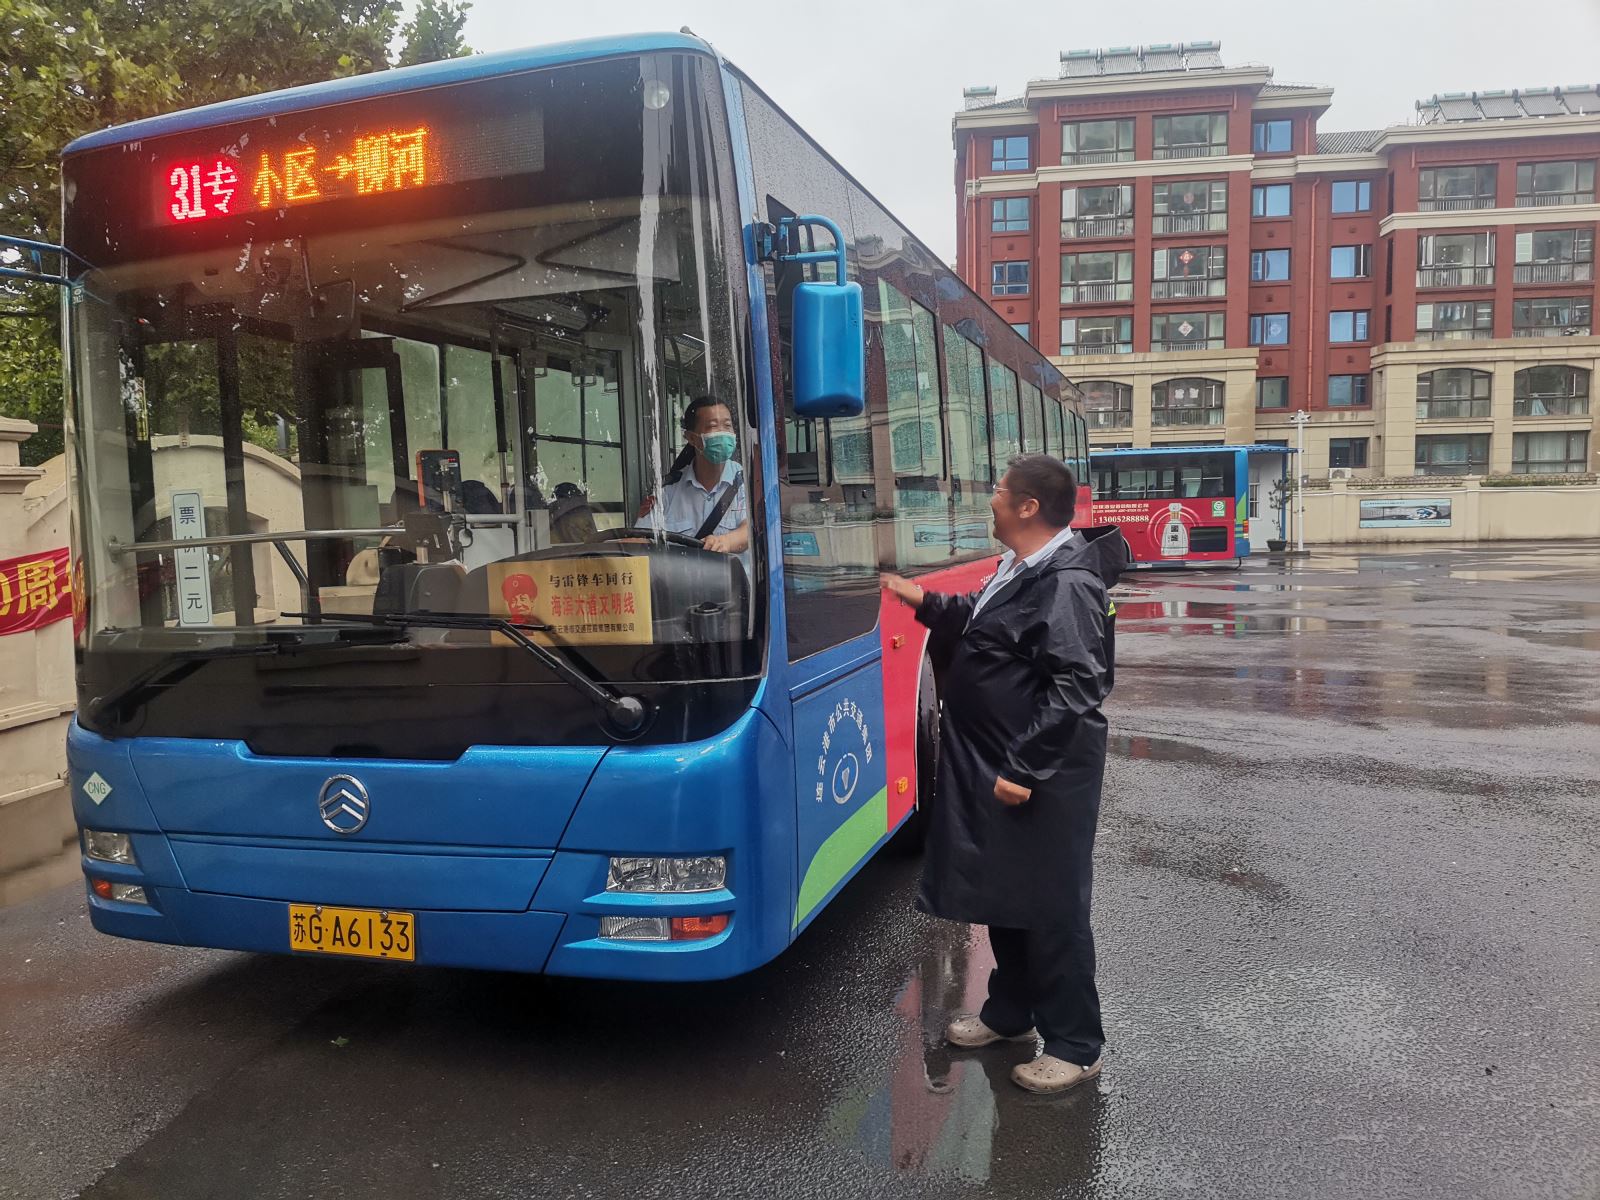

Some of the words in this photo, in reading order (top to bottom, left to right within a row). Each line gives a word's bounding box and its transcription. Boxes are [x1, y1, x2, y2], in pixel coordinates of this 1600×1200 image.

[170, 161, 237, 220] 31专
[549, 572, 634, 588] 与雷锋车同行
[551, 592, 635, 617] 海滨大道文明线
[87, 782, 107, 794] CNG
